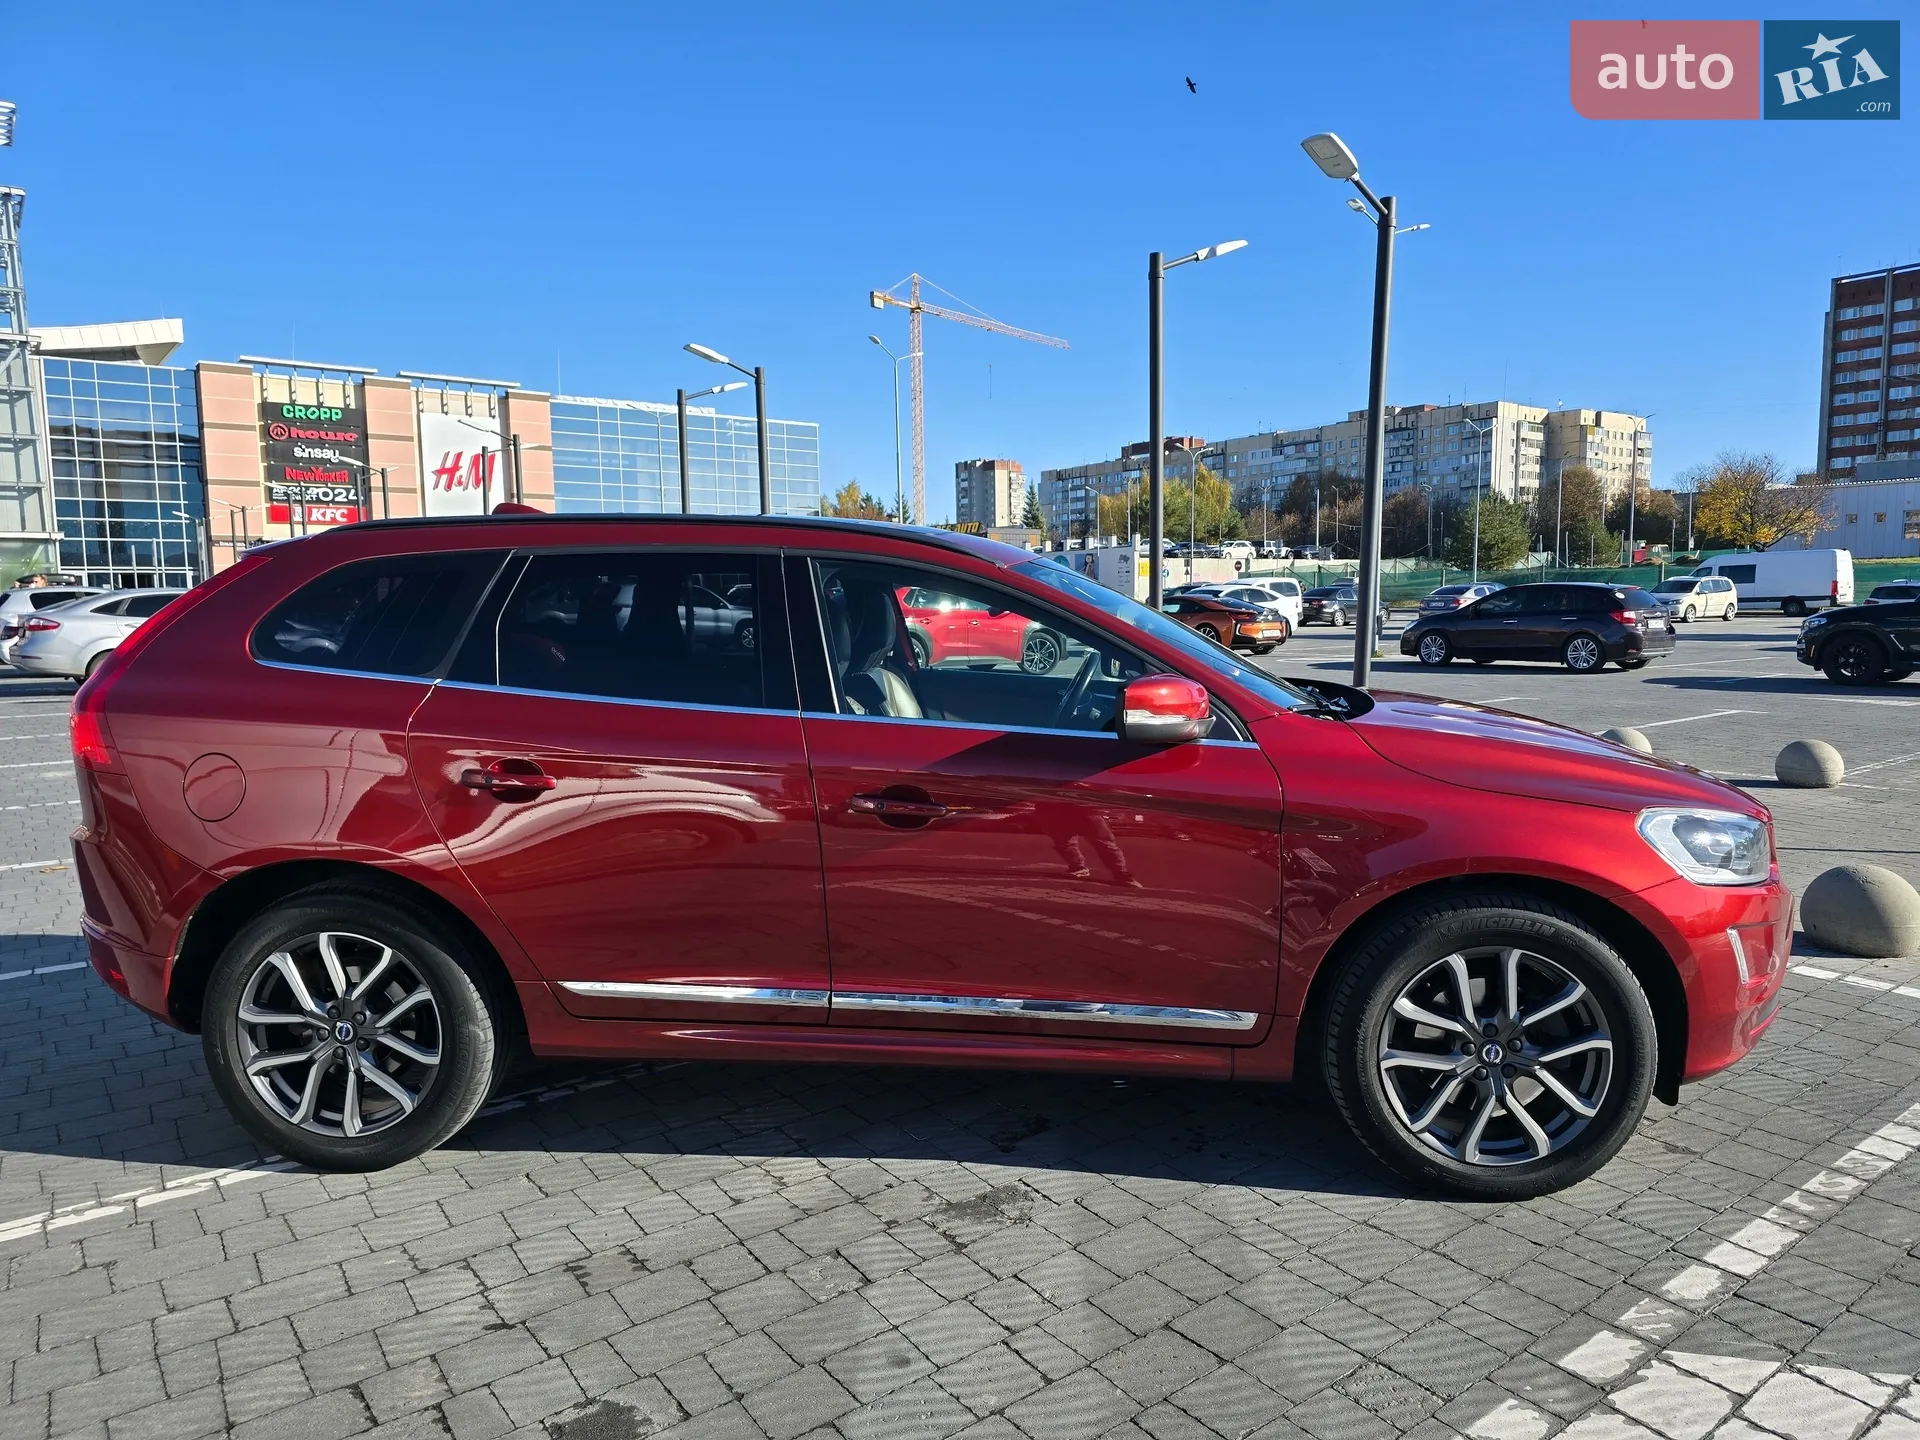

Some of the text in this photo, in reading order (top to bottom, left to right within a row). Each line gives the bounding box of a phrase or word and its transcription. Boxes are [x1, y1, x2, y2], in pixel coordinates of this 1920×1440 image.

[282, 404, 343, 421] CROPP
[290, 426, 358, 442] house
[431, 450, 496, 493] H&M
[309, 507, 349, 522] KFC
[955, 521, 980, 534] AUTO
[1461, 916, 1556, 938] MICHELIN
